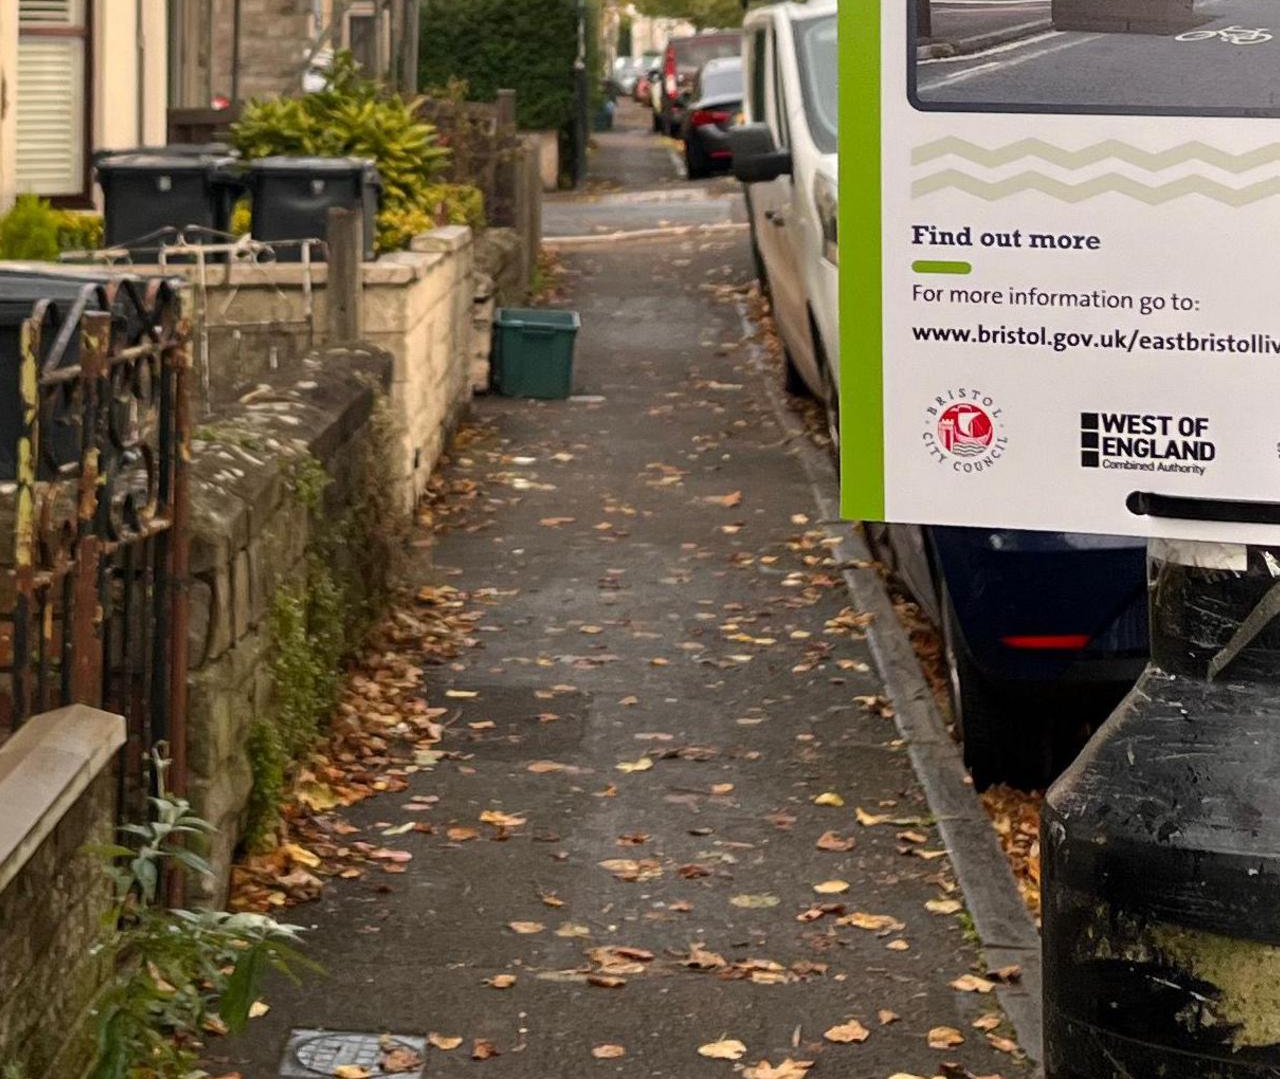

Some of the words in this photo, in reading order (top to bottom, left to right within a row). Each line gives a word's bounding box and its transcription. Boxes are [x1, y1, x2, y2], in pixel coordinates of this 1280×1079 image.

[911, 224, 974, 248] Find
[980, 228, 1022, 248] out
[1028, 234, 1101, 250] more
[912, 284, 944, 302] For
[950, 289, 1003, 305] more
[1009, 286, 1133, 309] information
[1139, 296, 1166, 316] go
[1170, 293, 1200, 311] to:
[927, 388, 1002, 418] BRISTOL
[1102, 413, 1173, 436] WEST
[1178, 416, 1209, 438] OF
[922, 431, 948, 464] CITY
[953, 436, 1008, 473] COUNCIL
[1102, 438, 1215, 462] ENGLAND
[1102, 458, 1154, 471] Combined
[1157, 461, 1206, 476] Authority
